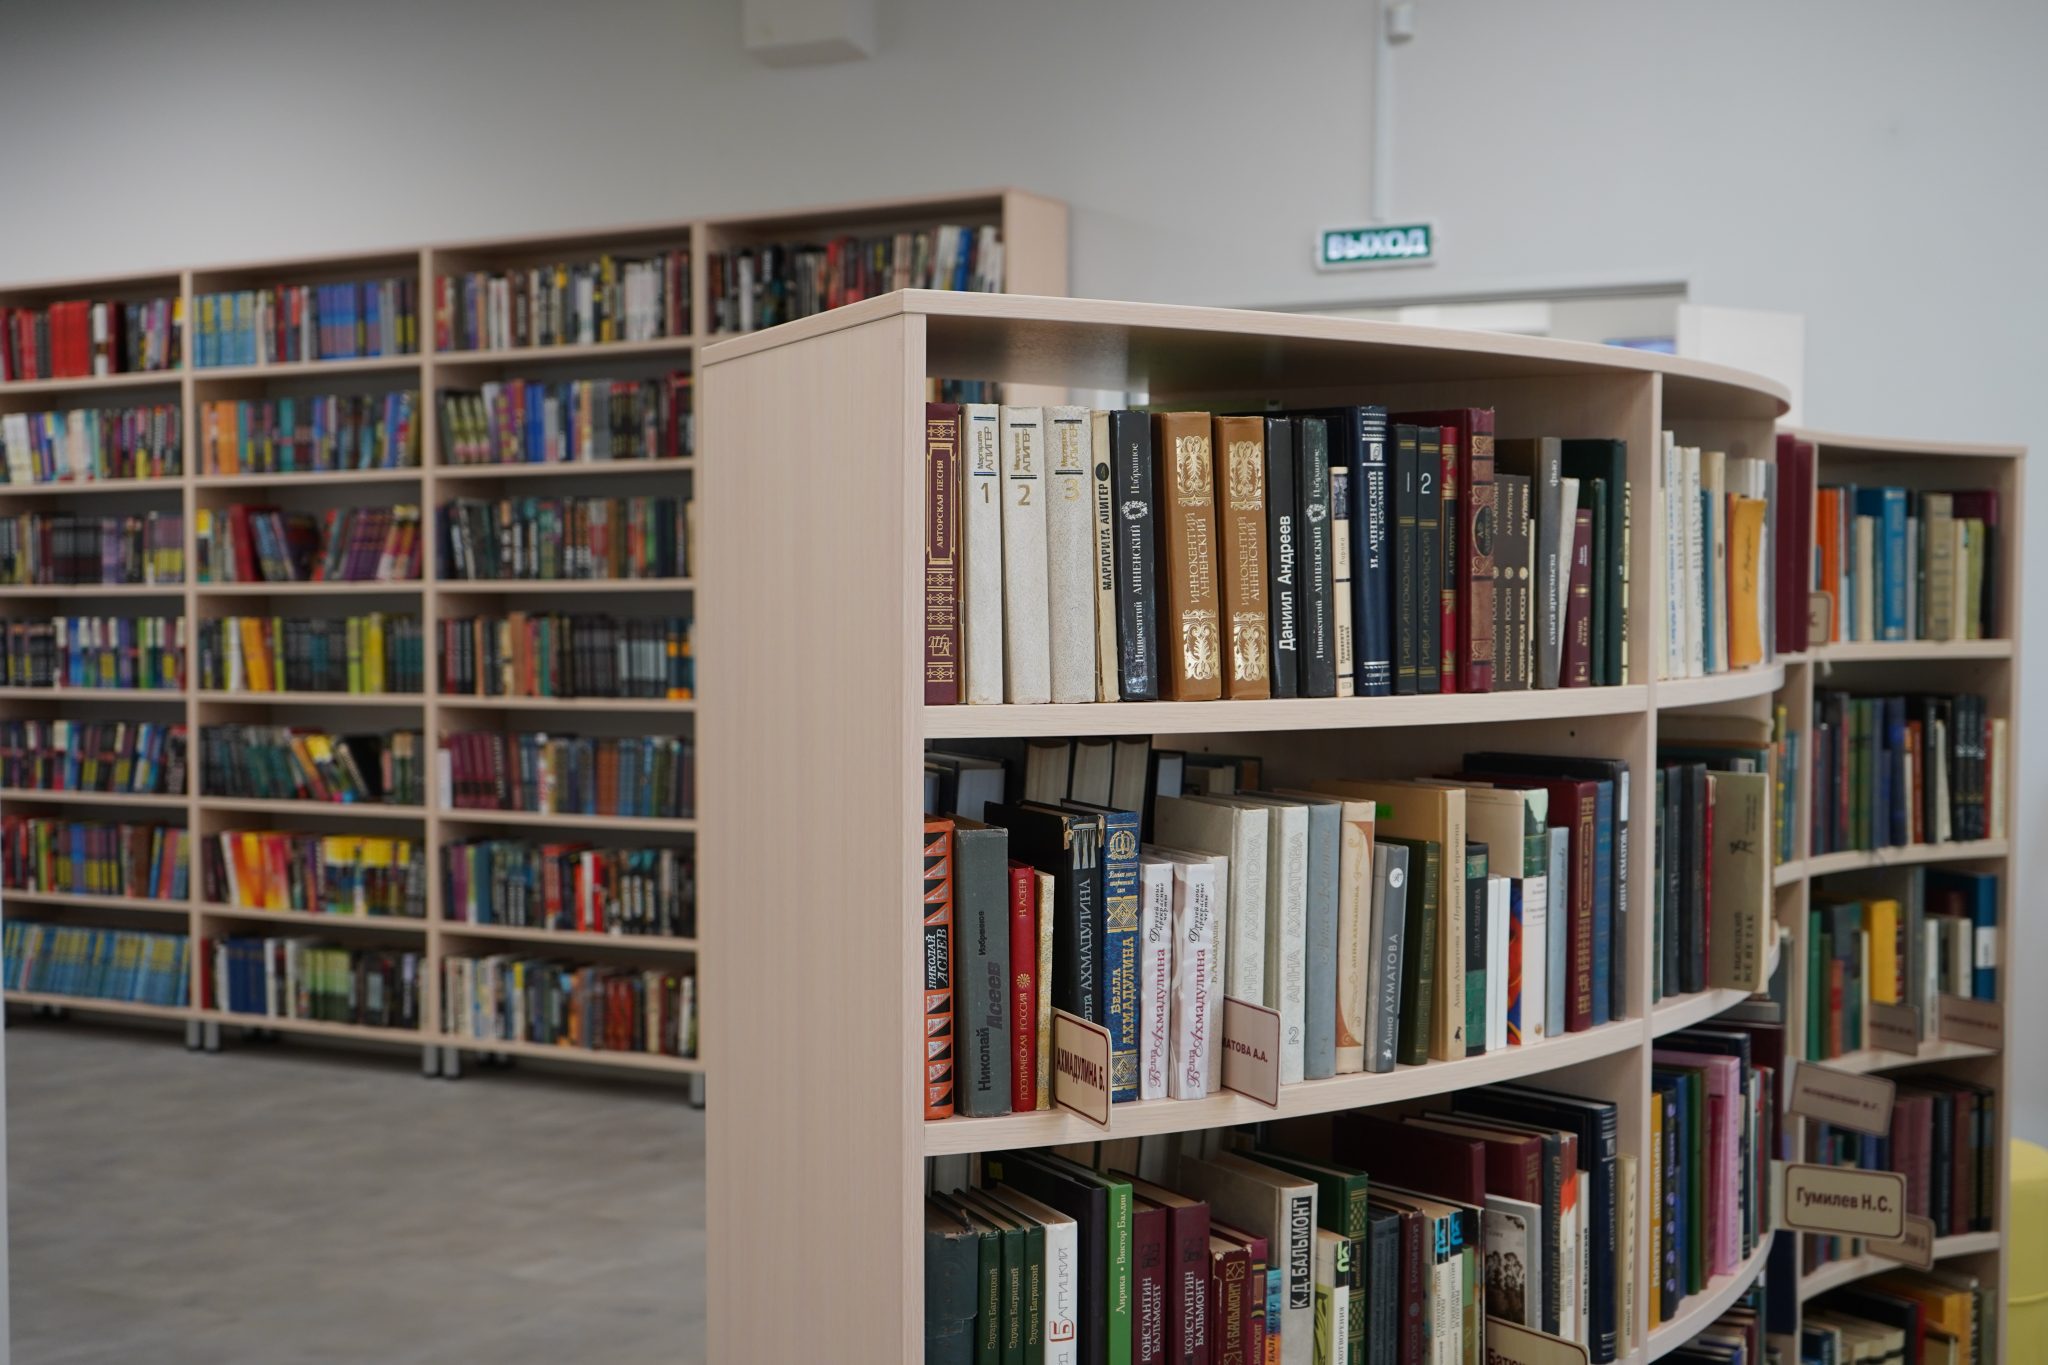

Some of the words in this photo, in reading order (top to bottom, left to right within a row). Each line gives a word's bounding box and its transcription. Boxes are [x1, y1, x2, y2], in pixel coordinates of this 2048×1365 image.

[1327, 228, 1429, 260] ВЫХОД
[984, 426, 994, 471] АЛИГЕР
[1022, 429, 1031, 472] АЛИГЕР
[1130, 442, 1142, 494] Избранное
[1312, 449, 1322, 498] Избранное
[980, 482, 989, 503] 1
[1017, 484, 1030, 506] 2
[1064, 478, 1080, 501] 3
[1098, 484, 1110, 524] АЛИГЕР
[1420, 473, 1432, 494] 2
[936, 494, 944, 549] АВТОРСКАЯ
[1368, 470, 1378, 552] АННЕНСКИЙ
[1100, 528, 1112, 591] МАРГАРИТА
[1131, 525, 1143, 595] АННЕНСКИЙ
[1185, 512, 1199, 604] ИННОКЕНТИЙ
[1197, 518, 1210, 598] АННЕНСКИЙ
[1237, 516, 1250, 606] ИННОКЕНТИЙ
[1248, 522, 1260, 601] АННЕНСКИЙ
[1277, 515, 1294, 585] Андреев
[1313, 526, 1322, 592] АННЕНСКИЙ
[1370, 554, 1379, 569] И.
[1402, 527, 1410, 625] АНТОКОЛЬСКИЙ
[1422, 531, 1431, 625] АНТОКОЛЬСКИЙ
[1134, 601, 1144, 663] Иннокентий
[1278, 591, 1297, 651] Даниил
[1316, 600, 1324, 659] Иннокентий
[1402, 628, 1410, 665] ПАВЕЛ
[1422, 629, 1431, 666] ПАВЕЛ
[1018, 878, 1027, 906] АСЕЕВ
[1244, 834, 1261, 941] АХМАТОВА
[1287, 832, 1303, 937] АХМАТОВА
[978, 911, 988, 956] Избранное
[1078, 878, 1092, 988] АХМАДУЛИНА
[1150, 906, 1161, 944] Друзей
[1188, 906, 1200, 944] Друзей
[926, 934, 937, 990] НИКОЛАЙ
[936, 928, 949, 986] АСЕЕВ
[1286, 951, 1299, 1003] АННА
[1385, 933, 1399, 1014] АХМАТОВА
[986, 961, 1002, 1030] Асеев
[1019, 992, 1028, 1030] РОССИЯ
[1083, 993, 1092, 1023] елла
[1110, 967, 1121, 1015] Белла
[1122, 937, 1135, 1045] АХМАДУЛИНА
[1151, 949, 1166, 1056] Ахмадулина
[1191, 949, 1207, 1056] Ахмадулина
[1253, 1048, 1268, 1062] А.А.
[1383, 1017, 1393, 1046] Анна
[976, 1027, 990, 1092] Николай
[1020, 1034, 1028, 1101] ПОЭТИЧЕСКАЯ
[1057, 1047, 1098, 1088] АХМАДУЛИНА
[1099, 1065, 1105, 1092] Б.
[1149, 1049, 1162, 1088] Белла
[1186, 1048, 1200, 1088] Белла
[1551, 1156, 1563, 1248] БЕЗЫМЕНСКИЙ
[1797, 1186, 1858, 1209] Гумилев
[1861, 1193, 1893, 1214] Н.С.
[1116, 1230, 1127, 1265] Виктор
[987, 1267, 999, 1316] Багрицкий
[1009, 1266, 1020, 1316] Багрицкий
[1029, 1264, 1040, 1312] Багрицкий
[1115, 1274, 1127, 1315] Лирика
[1195, 1278, 1205, 1346] БАЛЬМОНТ
[1551, 1251, 1561, 1321] АЛЕКСАНДР
[987, 1316, 999, 1350] Эдуард
[1008, 1316, 1019, 1349] Эдуард
[1029, 1313, 1040, 1345] Эдуард
[1141, 1276, 1152, 1362] КОНСТАНТИН
[1152, 1284, 1161, 1353] БАЛЬМОНТ
[1184, 1271, 1195, 1356] КОНСТАНТИН
[1267, 1302, 1277, 1363] БАЛЬМОНТ
